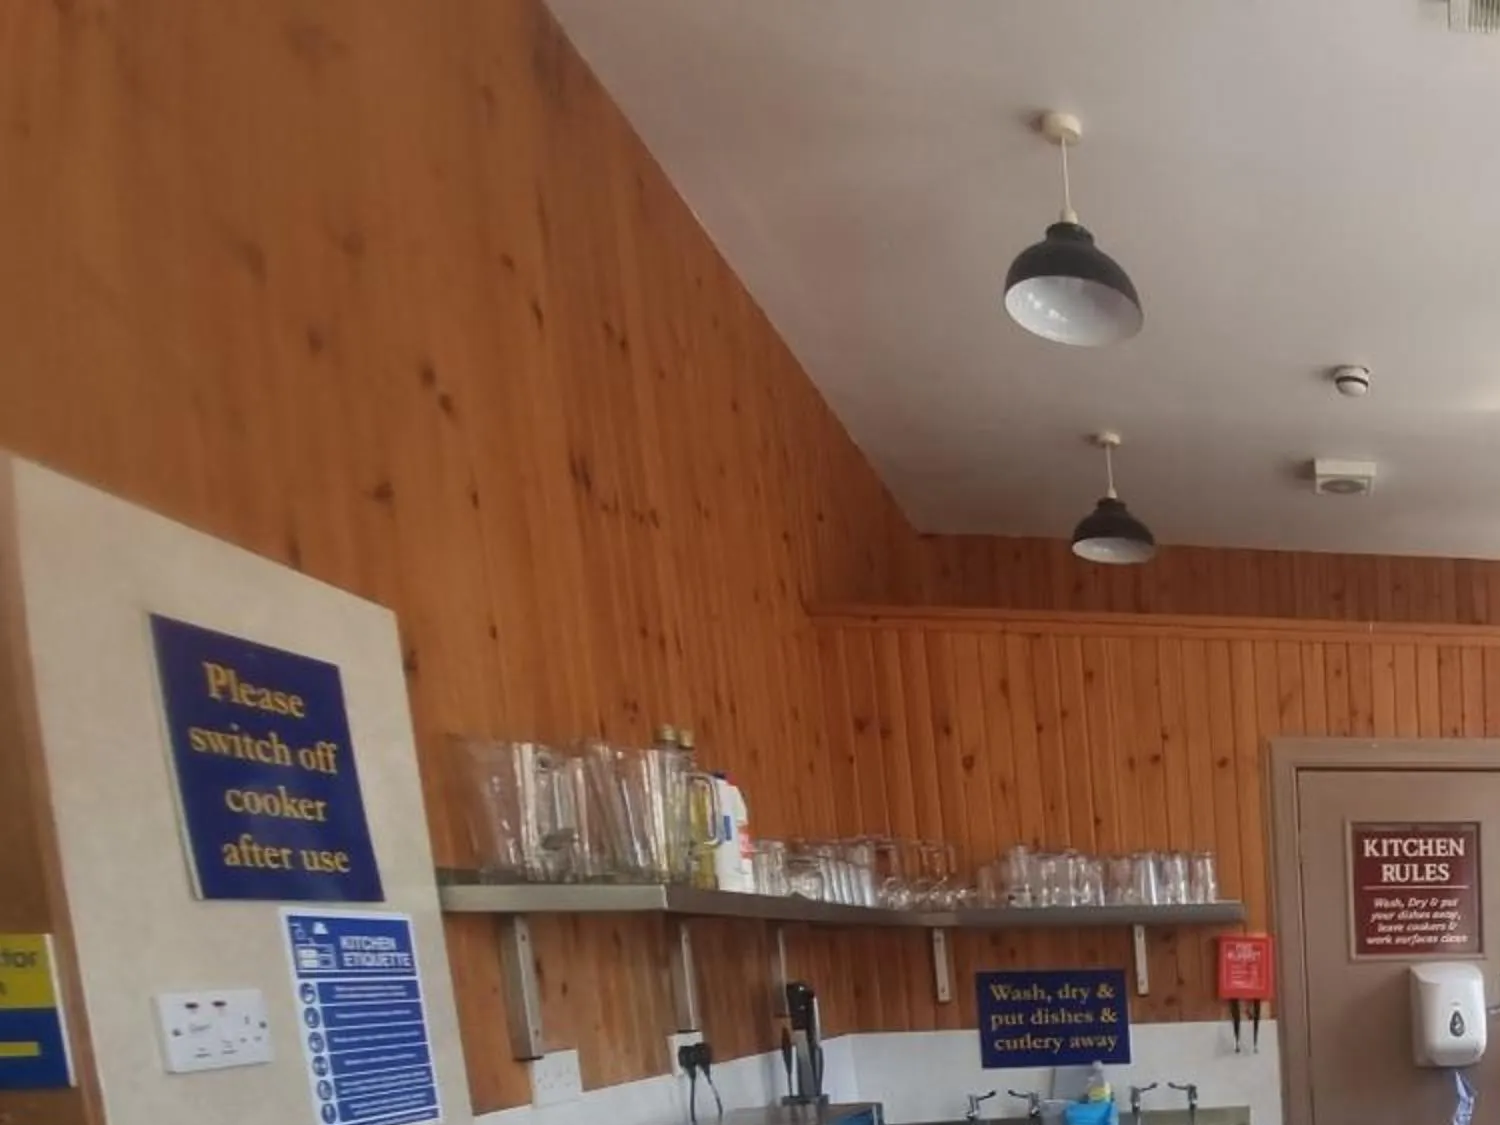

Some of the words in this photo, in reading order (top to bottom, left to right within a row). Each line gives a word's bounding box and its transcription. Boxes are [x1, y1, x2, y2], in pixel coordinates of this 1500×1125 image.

[203, 661, 305, 717] Please
[188, 722, 293, 767] switch
[299, 740, 338, 775] off
[224, 785, 328, 822] cooker
[222, 833, 293, 870] after
[301, 849, 351, 873] use
[1363, 837, 1465, 858] KITCHEN
[1381, 863, 1451, 883] RULES
[1373, 897, 1405, 909] Wash,
[1407, 897, 1430, 909] Dry
[1440, 898, 1460, 909] put
[340, 935, 397, 950] KITCHEN
[1365, 934, 1393, 945] work
[1394, 933, 1440, 947] surfaces
[343, 952, 412, 968] ETIQUETTE
[990, 983, 1051, 1003] Wash,
[1057, 983, 1090, 1005] dry
[1096, 983, 1116, 1000] &
[991, 1012, 1025, 1031] put
[1030, 1007, 1094, 1025] dishes
[1100, 1007, 1119, 1023] &
[994, 1033, 1064, 1055] cutlery
[1069, 1036, 1119, 1052] away
